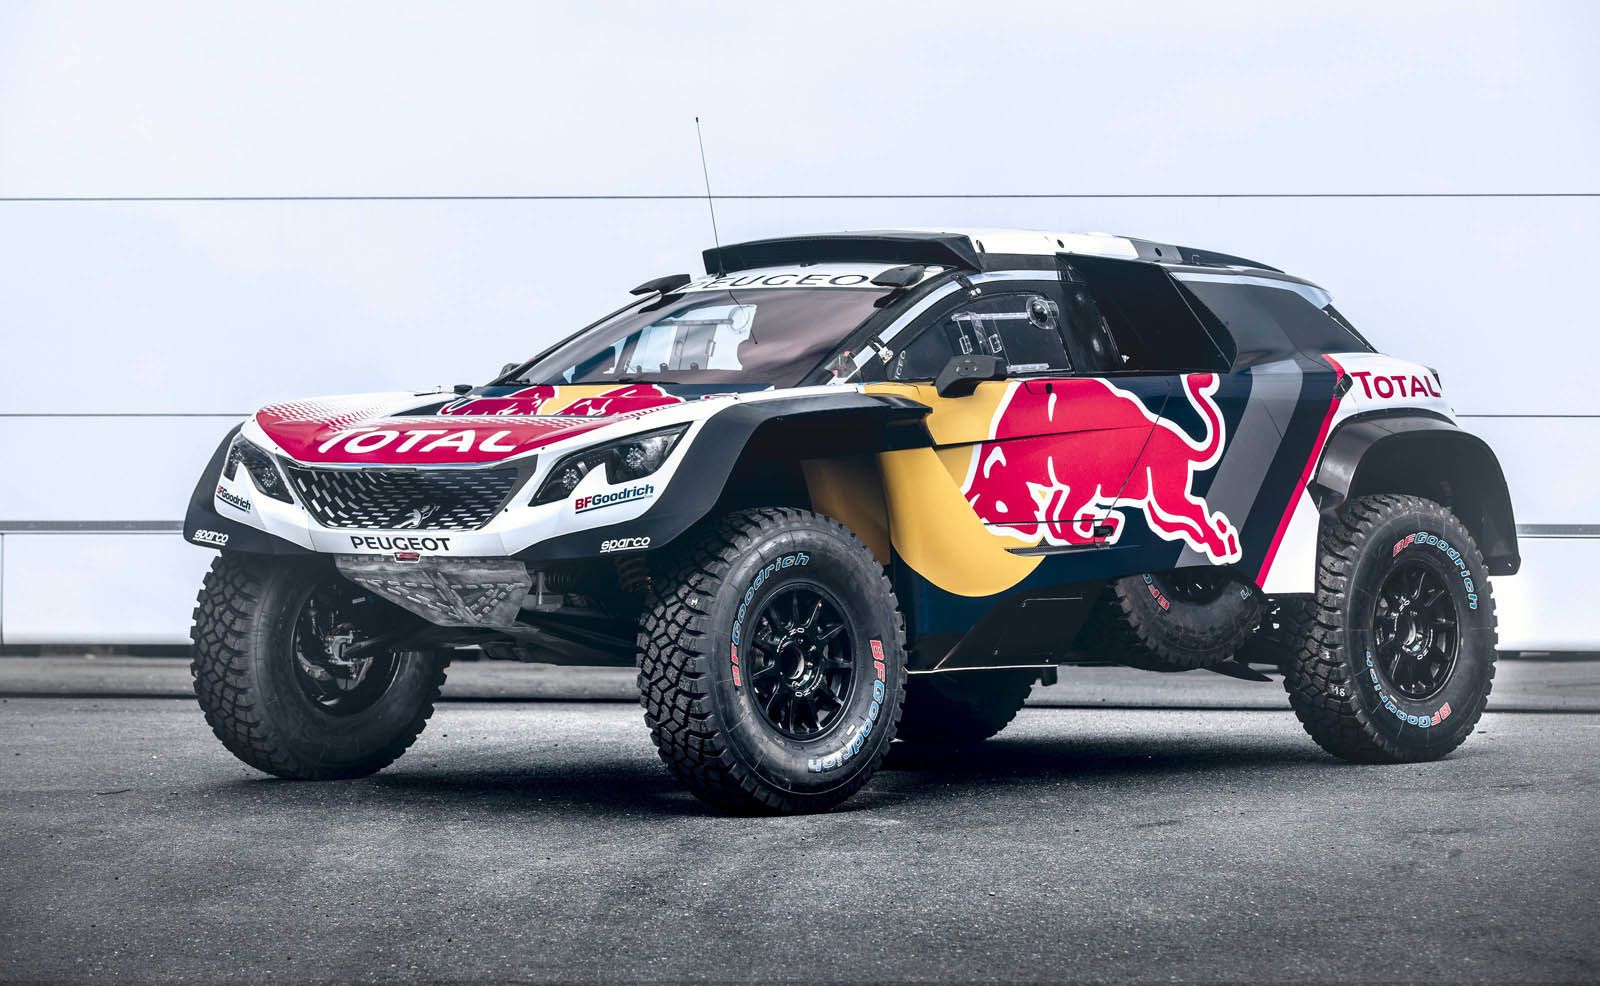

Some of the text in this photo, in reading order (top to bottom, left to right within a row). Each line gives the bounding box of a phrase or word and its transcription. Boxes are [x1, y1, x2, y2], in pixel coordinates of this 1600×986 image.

[674, 274, 869, 293] PEUGEO
[1350, 371, 1441, 399] TOTAL
[318, 427, 518, 453] TOTAL
[216, 485, 251, 511] BFGoodrich
[575, 484, 654, 511] BFGoodrich
[193, 529, 229, 544] sparco
[350, 536, 450, 551] PEUGEOT
[600, 537, 651, 553] sparco
[1393, 531, 1478, 610] BFGoodrich
[808, 639, 886, 772] BFGoodrich
